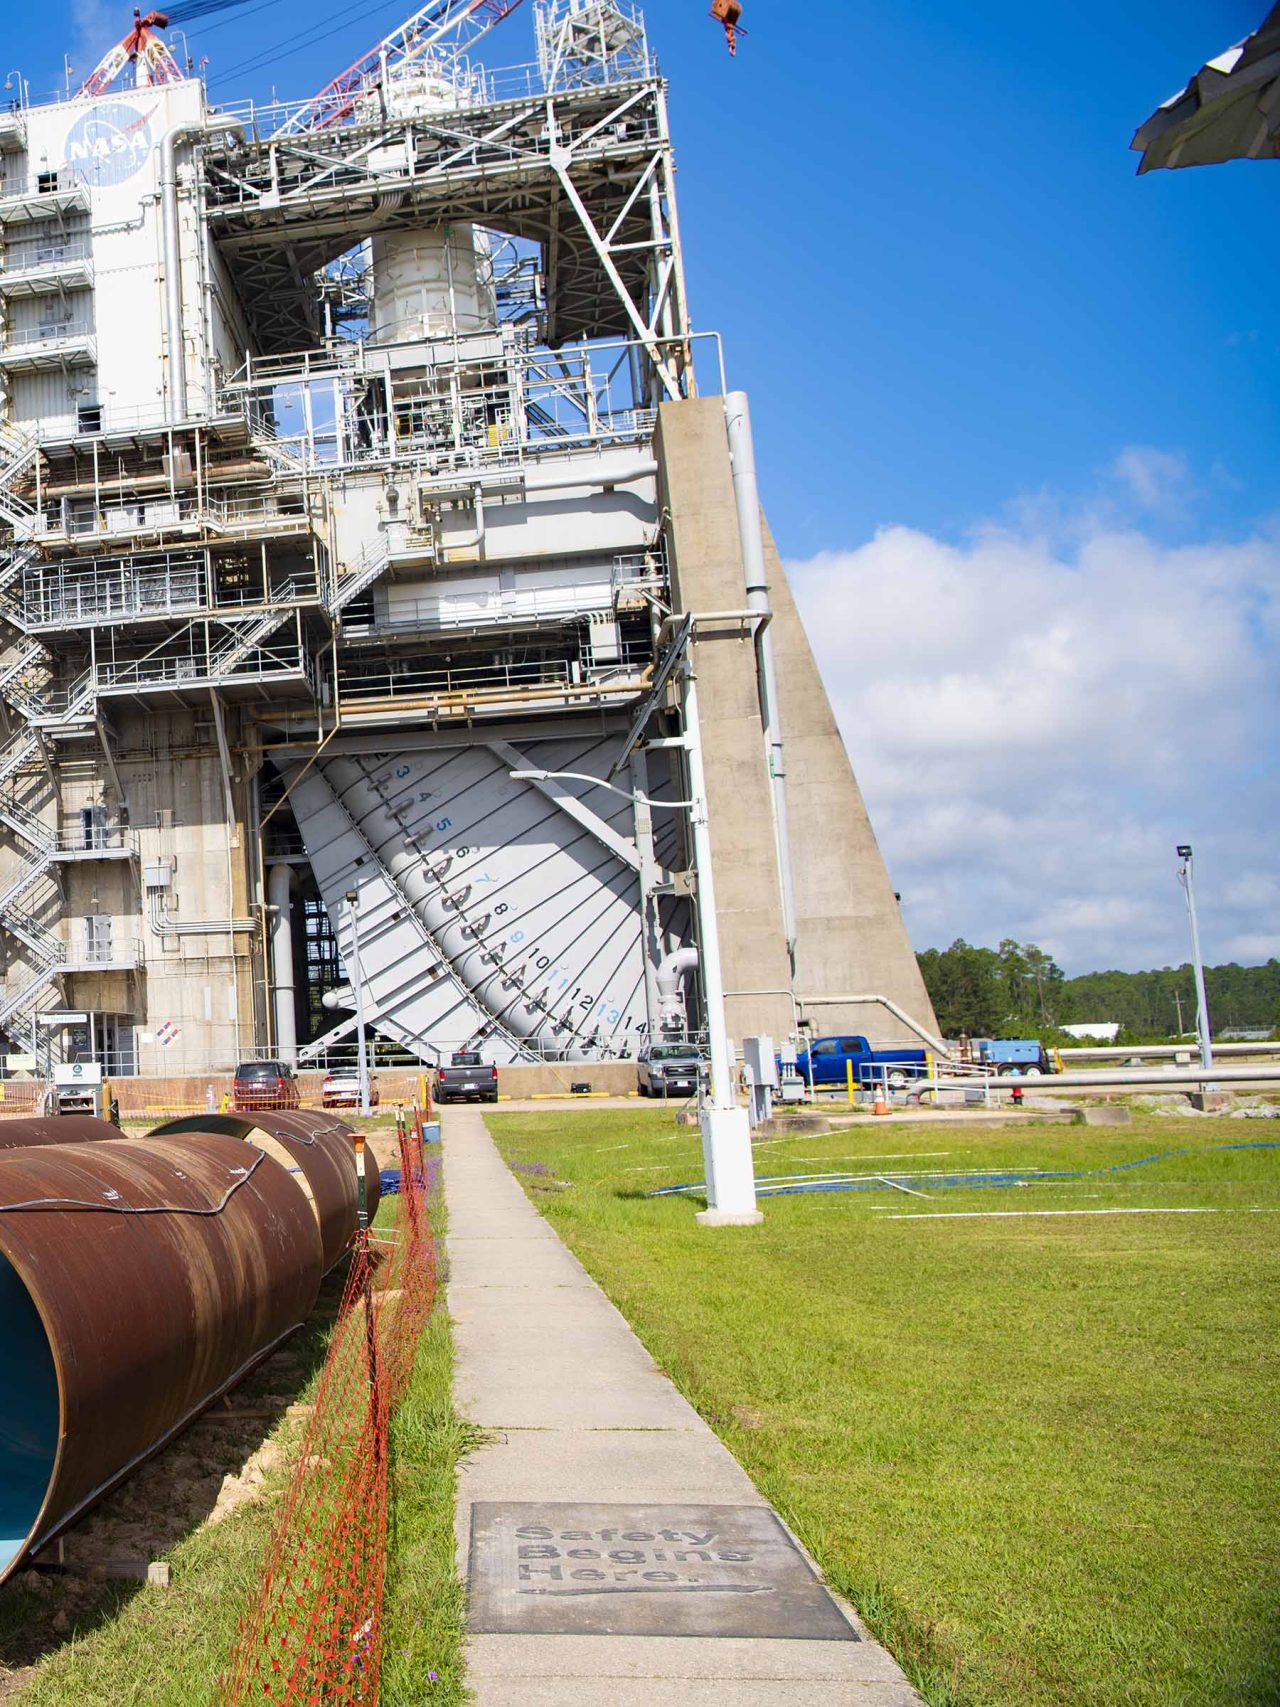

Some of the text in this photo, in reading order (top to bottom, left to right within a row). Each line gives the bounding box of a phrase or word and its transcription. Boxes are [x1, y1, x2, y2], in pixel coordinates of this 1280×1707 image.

[70, 130, 150, 160] NASA
[396, 765, 410, 778] 3
[419, 792, 432, 802] 4
[437, 817, 452, 831] 5
[456, 846, 470, 858] 6
[474, 873, 490, 883] 7
[494, 903, 508, 915] 8
[528, 948, 550, 969] 10
[548, 970, 568, 990] 11
[571, 988, 593, 1010] 12
[597, 1003, 619, 1024] 13
[625, 1016, 647, 1034] 14
[515, 1526, 719, 1546] Safety
[517, 1544, 754, 1565] Begins
[518, 1563, 699, 1582] Here.
